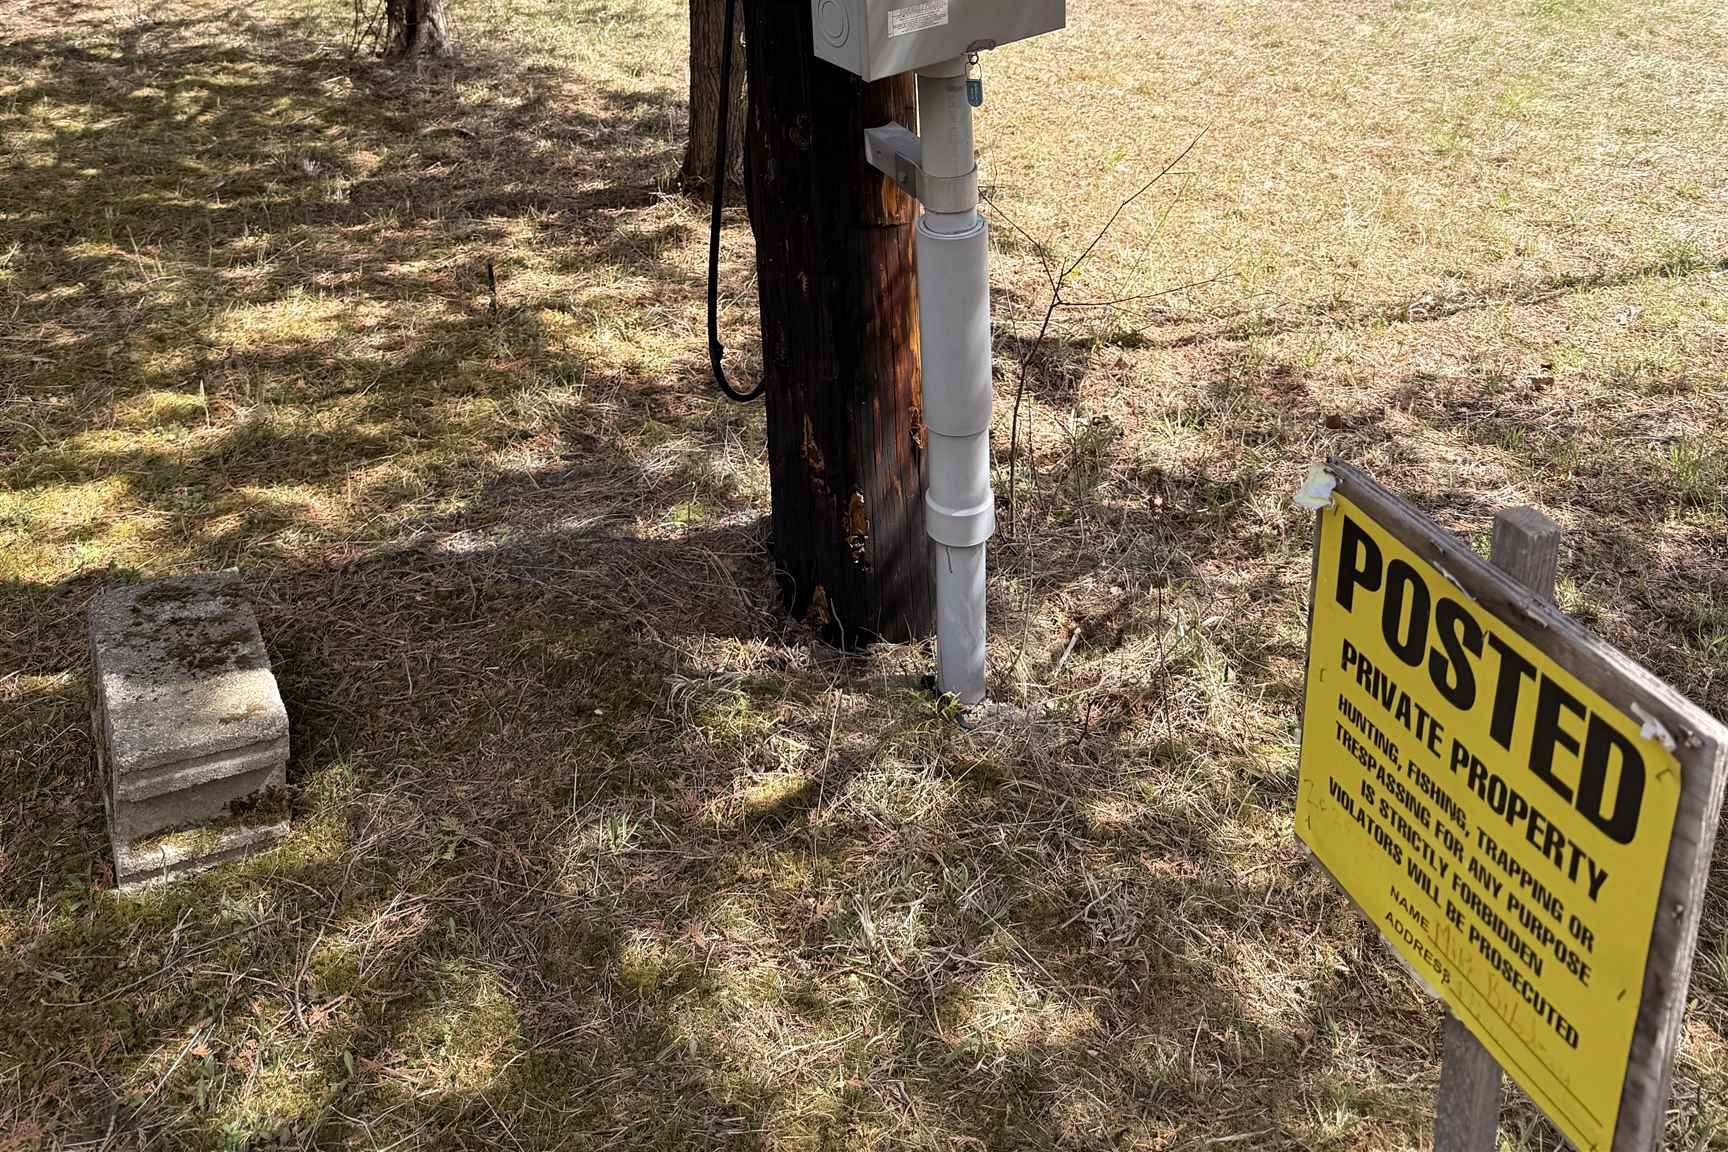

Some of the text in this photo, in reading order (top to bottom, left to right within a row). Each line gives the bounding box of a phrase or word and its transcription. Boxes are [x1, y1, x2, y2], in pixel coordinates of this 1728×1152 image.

[1335, 514, 1647, 846] POSTED
[1340, 638, 1609, 903] PRIVATE PROPERTY
[1328, 776, 1402, 866] VIOLATORS
[1407, 858, 1442, 908] WILL
[1446, 898, 1466, 934] BE
[1468, 924, 1580, 1050] PROSECUTED
[1335, 720, 1431, 830] TRESPASSING
[1434, 819, 1465, 864] FOR
[1468, 856, 1503, 900] ANY
[1506, 891, 1592, 988] PURPOSE
[1337, 694, 1403, 771] HUNTING,
[1407, 760, 1470, 838] FISHING,
[1476, 826, 1564, 923] TRAPPING
[1569, 915, 1595, 954] OR
[1361, 779, 1375, 806] IS
[1379, 798, 1449, 879] STRICTLY
[1452, 871, 1544, 978] FORBIDDEN
[1389, 885, 1431, 933] NAME
